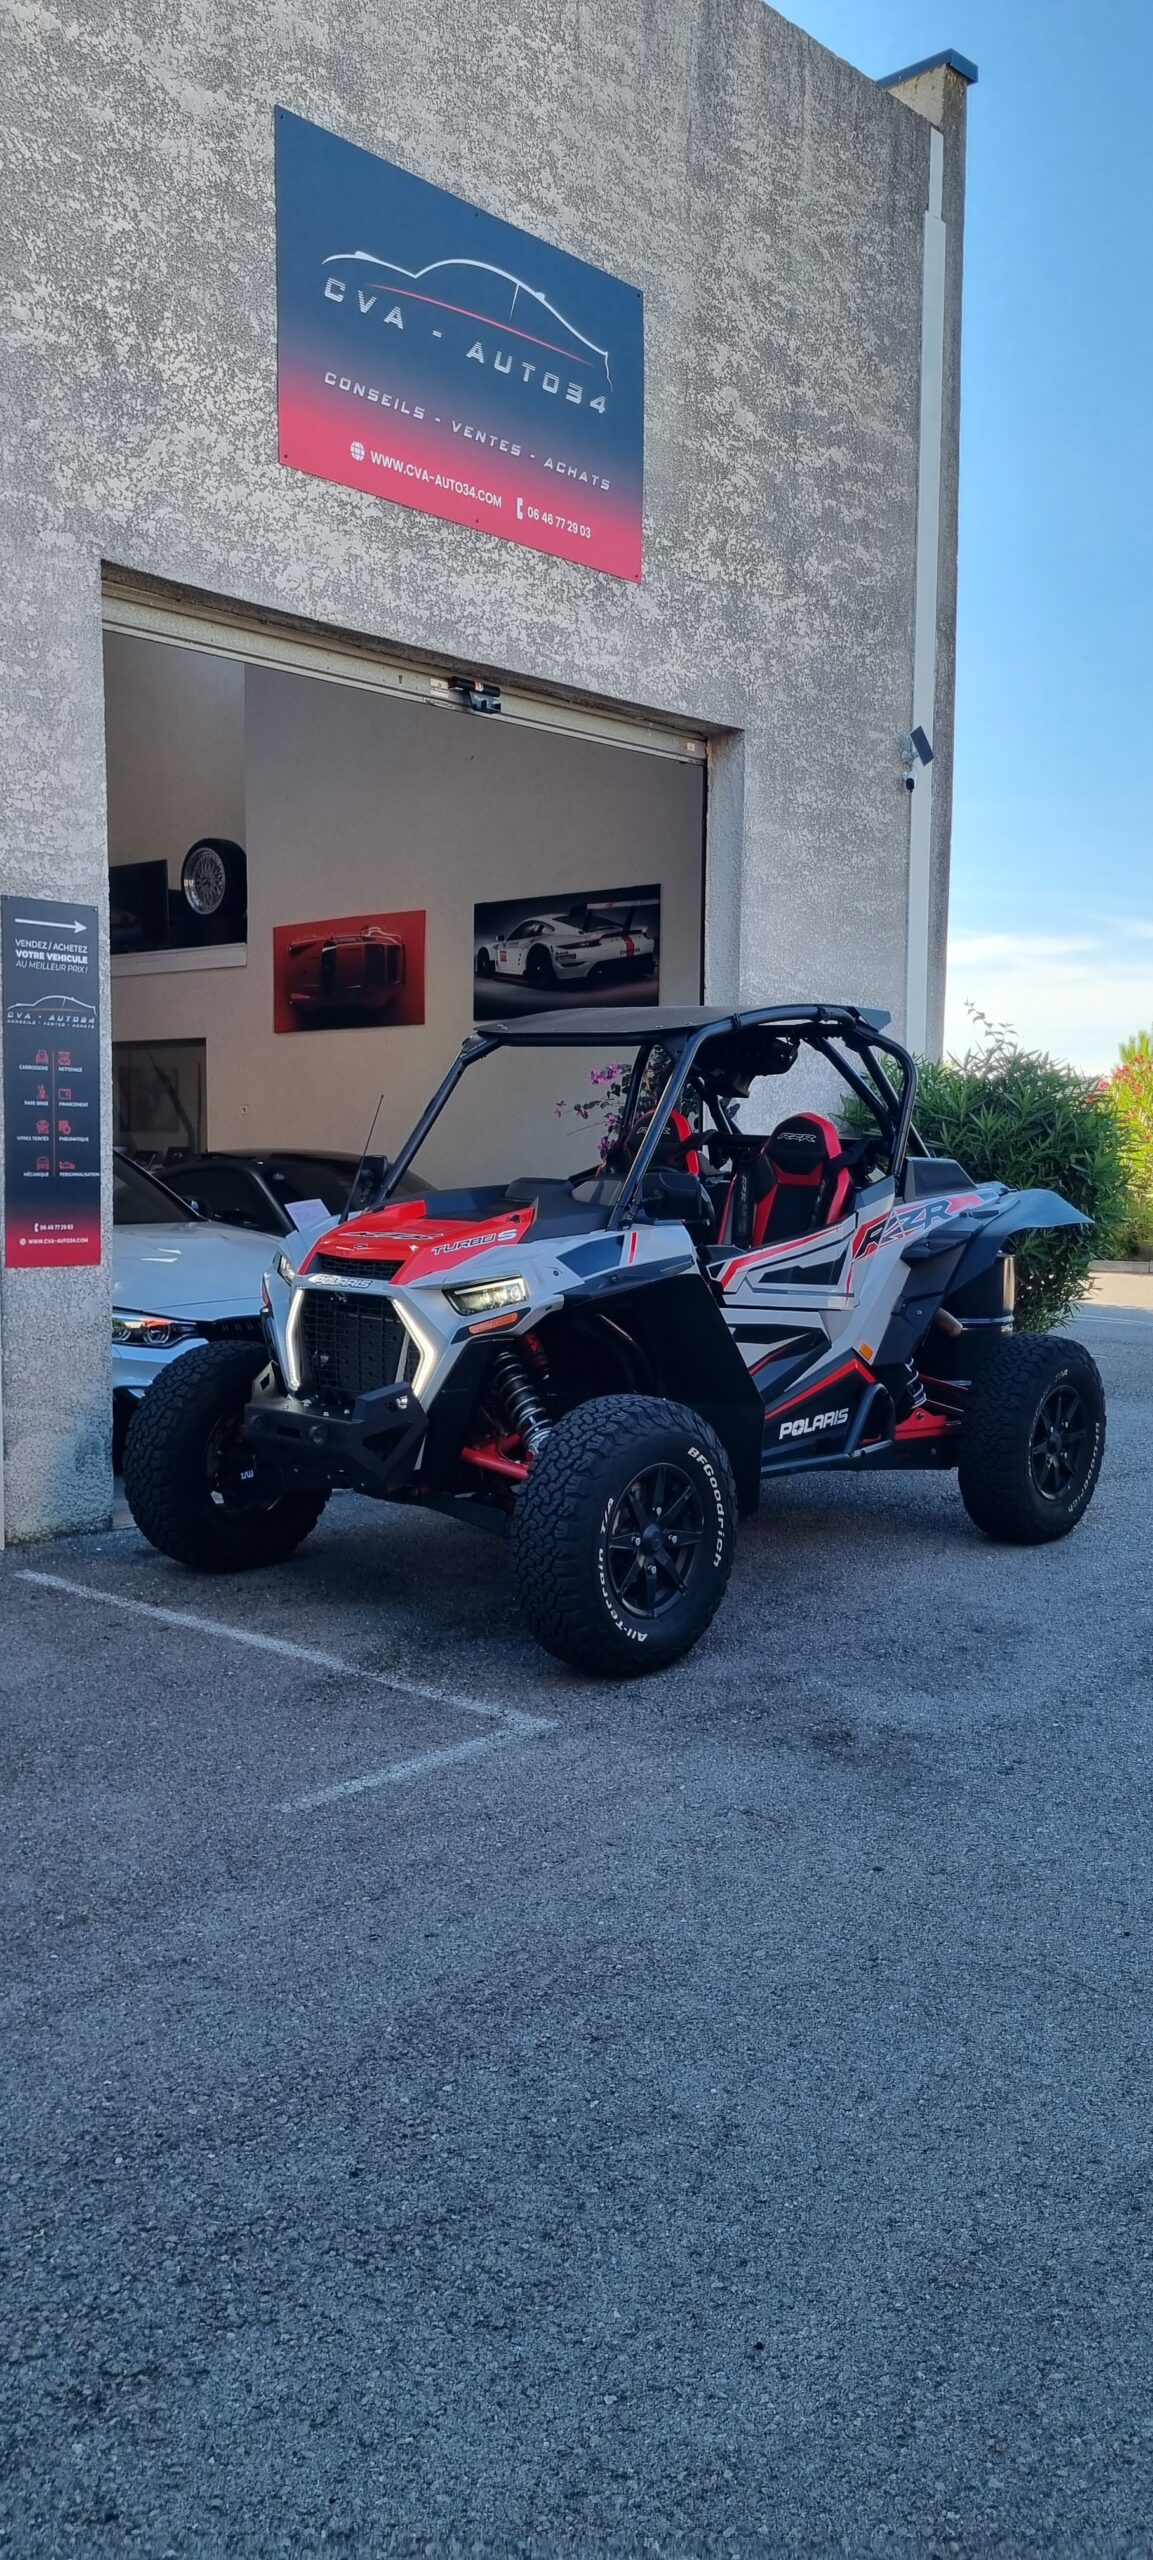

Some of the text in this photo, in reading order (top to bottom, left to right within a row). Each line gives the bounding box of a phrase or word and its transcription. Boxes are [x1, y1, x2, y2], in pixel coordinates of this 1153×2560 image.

[323, 277, 404, 330] CVA
[466, 341, 608, 414] AUTO34
[324, 371, 425, 420] CONSEILS
[451, 420, 522, 457] VENTES
[543, 457, 611, 491] ACHATS
[370, 450, 502, 508] WWW.CVA-AUTO34.COM
[527, 506, 591, 539] 06 46 77 29 03
[15, 938, 48, 950] VENDEZ
[53, 942, 88, 954] ACHETEZ
[15, 949, 88, 964] VOTRE VEHICULE
[16, 959, 28, 969] AU
[28, 961, 67, 972] MEILLEUR
[777, 1132, 817, 1143] RZR
[432, 1233, 495, 1255] TURBO
[497, 1229, 518, 1242] S
[851, 1198, 954, 1262] RZR
[315, 1273, 372, 1289] POLARIS
[779, 1407, 849, 1440] POLARIS
[687, 1446, 725, 1568] BFGoodrich
[598, 1548, 648, 1642] All-Terrain
